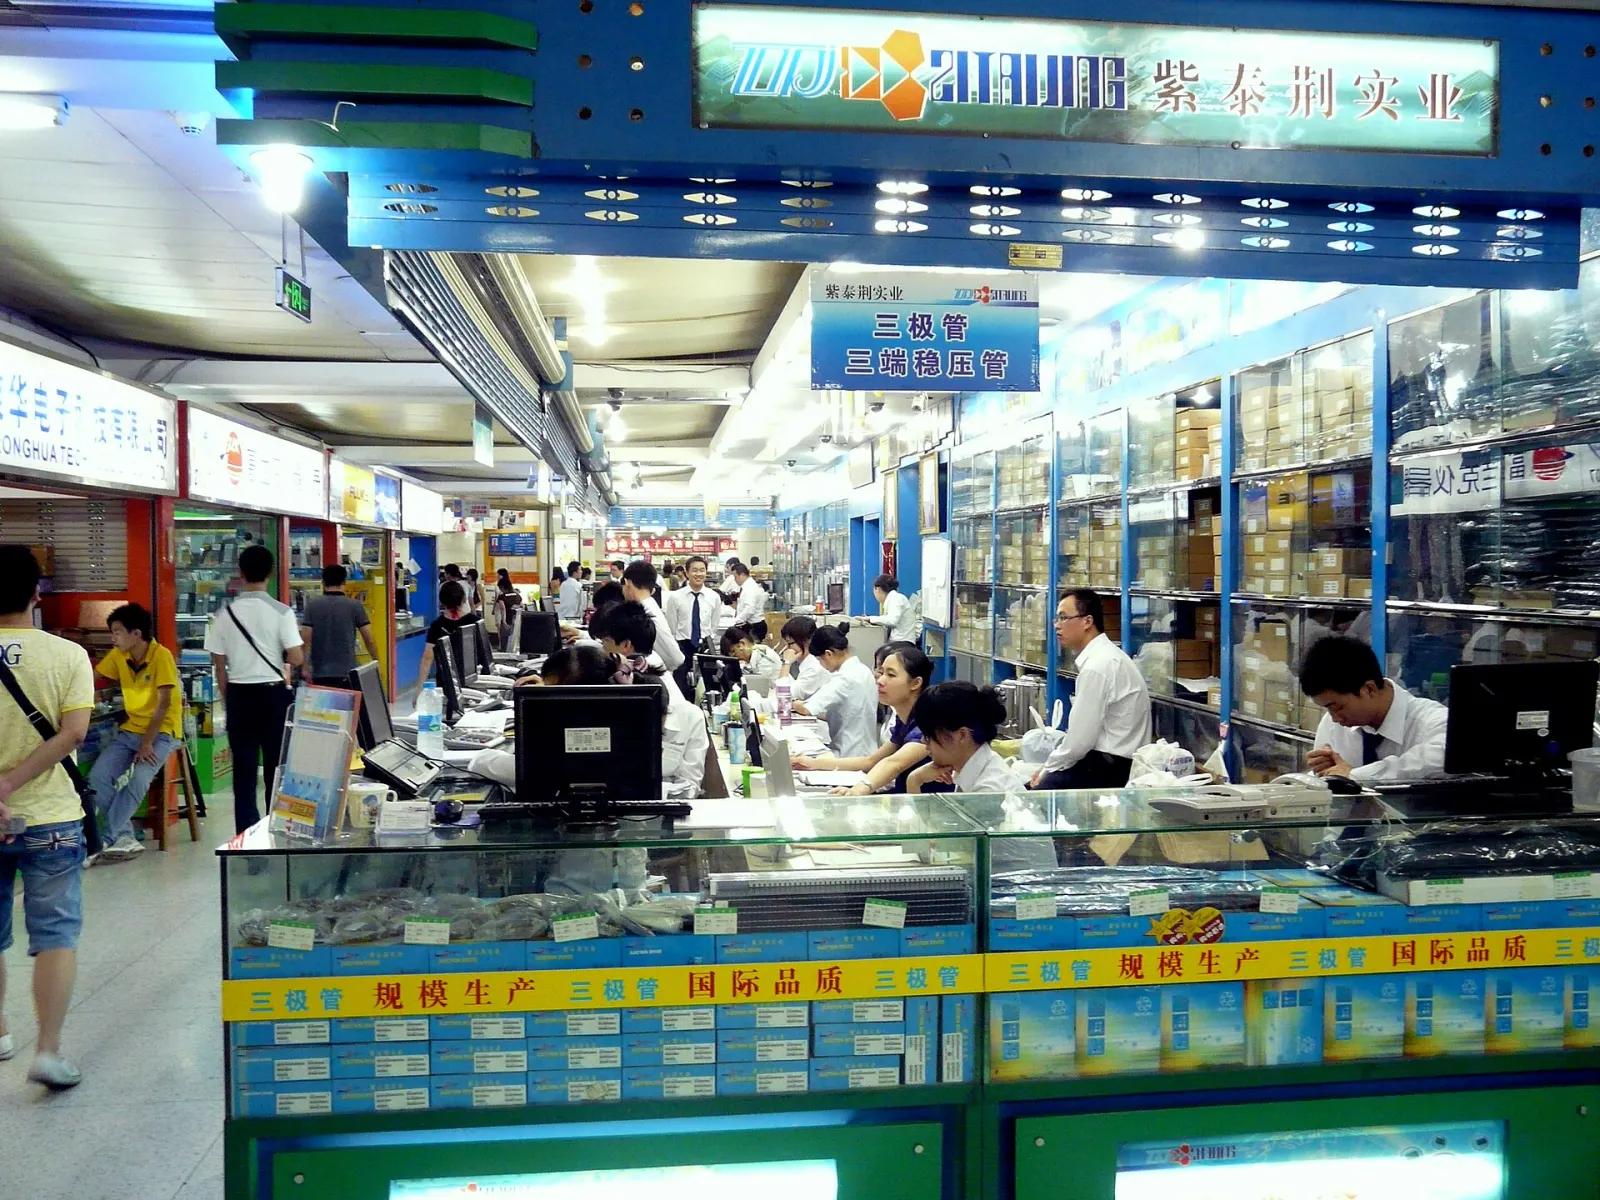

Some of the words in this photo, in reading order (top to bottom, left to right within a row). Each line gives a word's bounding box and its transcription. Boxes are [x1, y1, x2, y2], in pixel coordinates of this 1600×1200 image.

[1153, 59, 1464, 122] 紫泰荆实业
[825, 284, 904, 301] 紫泰荆实业
[873, 312, 968, 340] 三极管
[845, 348, 1008, 378] 三端稳压管
[0, 435, 57, 464] ONGHUA
[1009, 959, 1091, 984] 三极管
[1118, 947, 1260, 980] 规模生产
[1289, 947, 1366, 971] 三极管
[1392, 935, 1527, 968] 国际品质
[1556, 938, 1600, 960] 三极
[250, 987, 343, 1013] 三极管
[373, 976, 535, 1009] 规模生产
[569, 977, 659, 1002] 三极管
[688, 965, 843, 999] 国际品质
[874, 965, 960, 991] 三极管
